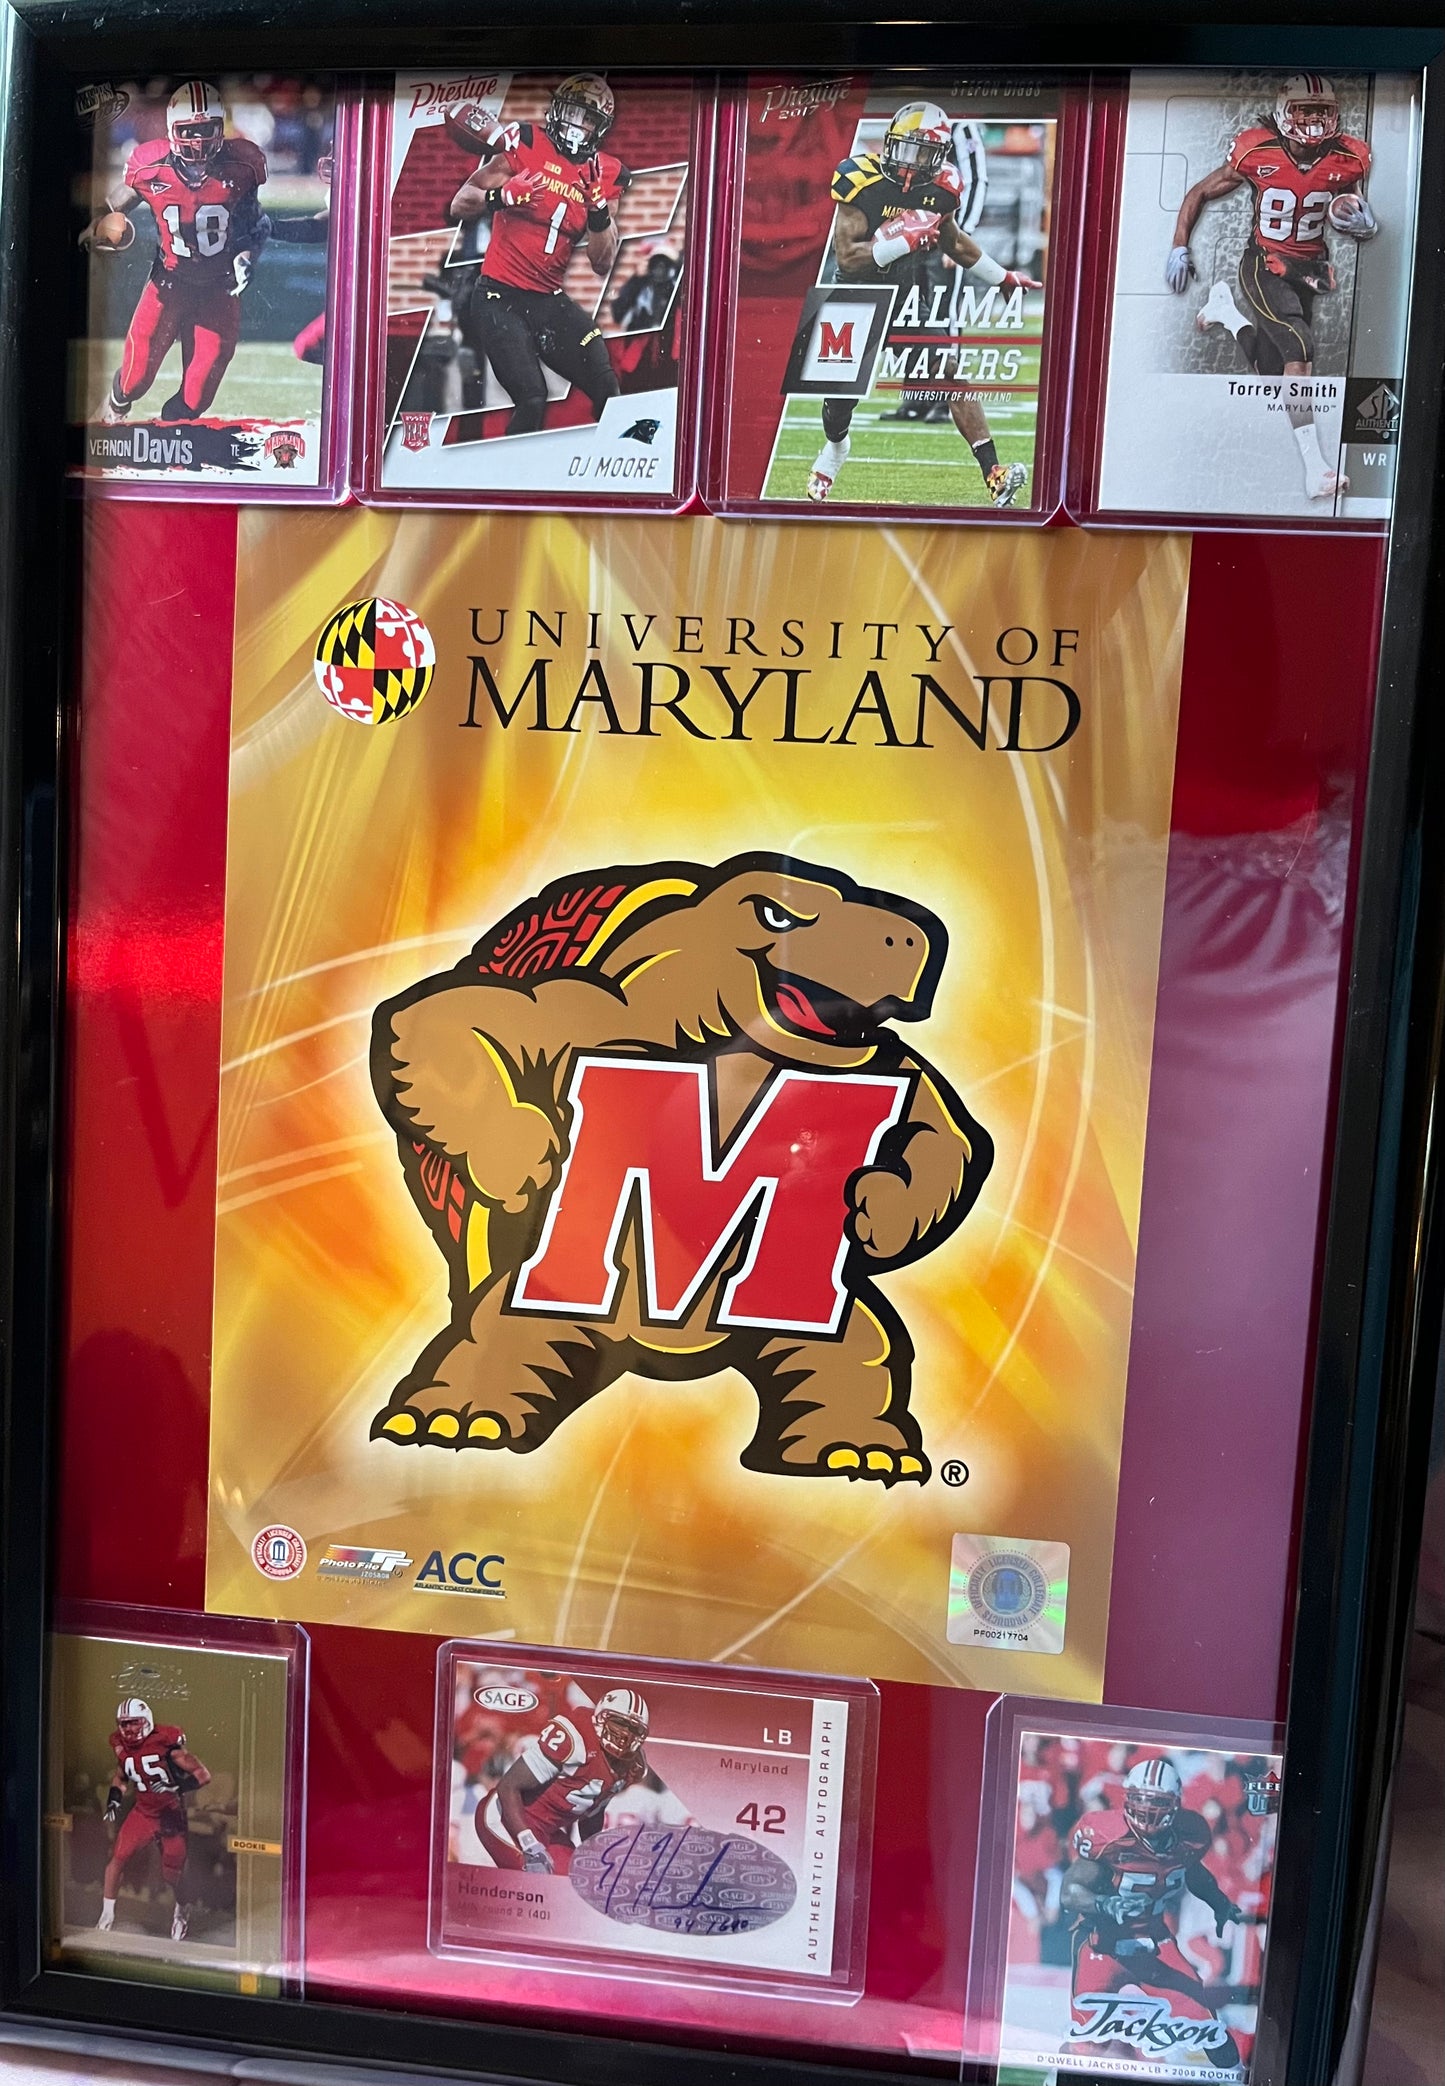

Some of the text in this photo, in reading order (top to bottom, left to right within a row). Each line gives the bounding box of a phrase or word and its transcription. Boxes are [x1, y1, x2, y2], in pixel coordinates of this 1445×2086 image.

[409, 74, 499, 118] Prestige
[760, 77, 854, 122] Prestige
[779, 105, 819, 119] 2017
[542, 176, 585, 204] MARYLAND
[544, 202, 567, 254] 1
[1259, 187, 1333, 242] 82
[163, 205, 229, 257] 10
[893, 285, 1024, 329] ALMA
[818, 322, 855, 358] M
[879, 347, 1021, 380] MATERS
[899, 390, 1012, 403] UNIVERSITY OF MARYLAND
[1229, 382, 1337, 399] Torrey Smith
[90, 428, 192, 464] VERNON Davis
[231, 444, 240, 457] TE
[1363, 452, 1387, 466] WR
[568, 456, 659, 479] DJ MOORE
[468, 607, 1082, 667] UNIVERSITY OF
[458, 656, 1083, 753] MARYLAND
[511, 1055, 912, 1335] M
[320, 1558, 380, 1570] Photo File
[416, 1550, 505, 1588] ACC
[414, 1583, 444, 1591] ATLANTIC
[465, 1587, 506, 1596] CONFERENCE
[973, 1629, 1028, 1641] PF00217704
[484, 1690, 526, 1708] SAGE
[540, 1724, 566, 1751] 42
[763, 1727, 792, 1745] LB
[125, 1755, 169, 1792] 45
[720, 1758, 788, 1775] Maryland
[735, 1802, 787, 1834] 42
[233, 1841, 266, 1850] ROOKIE
[808, 1721, 832, 1961] AUTHENTIC AUTOGRAPH
[458, 1882, 544, 1904] Henderson
[516, 1907, 524, 1917] 2
[528, 1909, 551, 1920] (40)
[1070, 1998, 1219, 2052] Jackson
[1037, 2055, 1084, 2067] D'QWELL
[1088, 2059, 1138, 2072] JACKSON
[1200, 2070, 1243, 2081] ROOKIE
